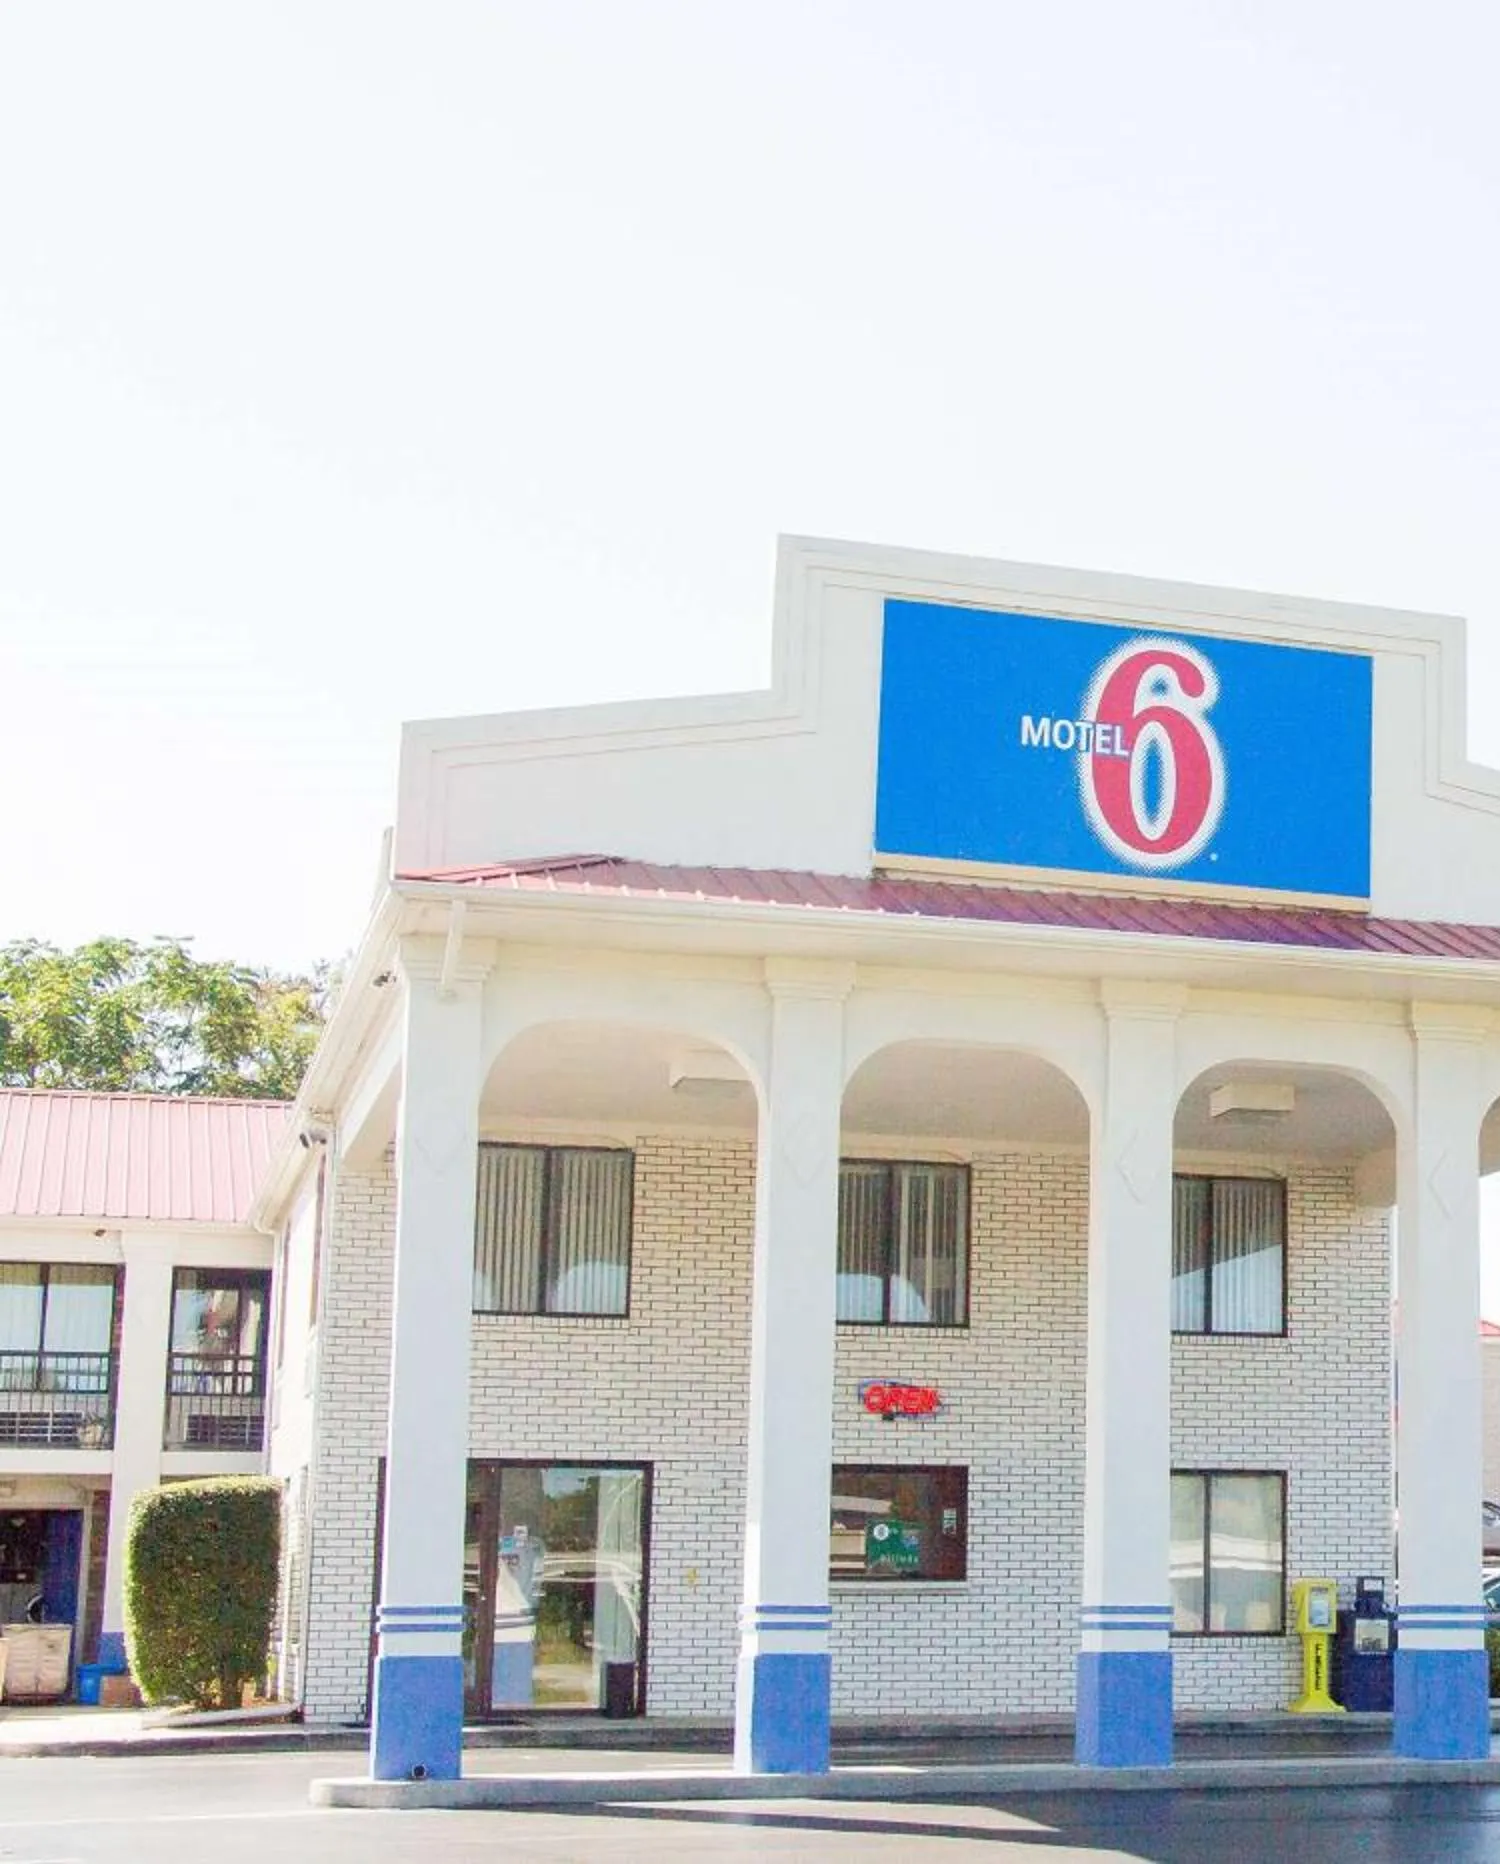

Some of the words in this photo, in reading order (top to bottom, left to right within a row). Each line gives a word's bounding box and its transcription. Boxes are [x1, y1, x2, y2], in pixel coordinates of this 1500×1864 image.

[1020, 714, 1130, 757] MOTEL
[1089, 646, 1216, 858] 6
[865, 1385, 938, 1413] OPEN
